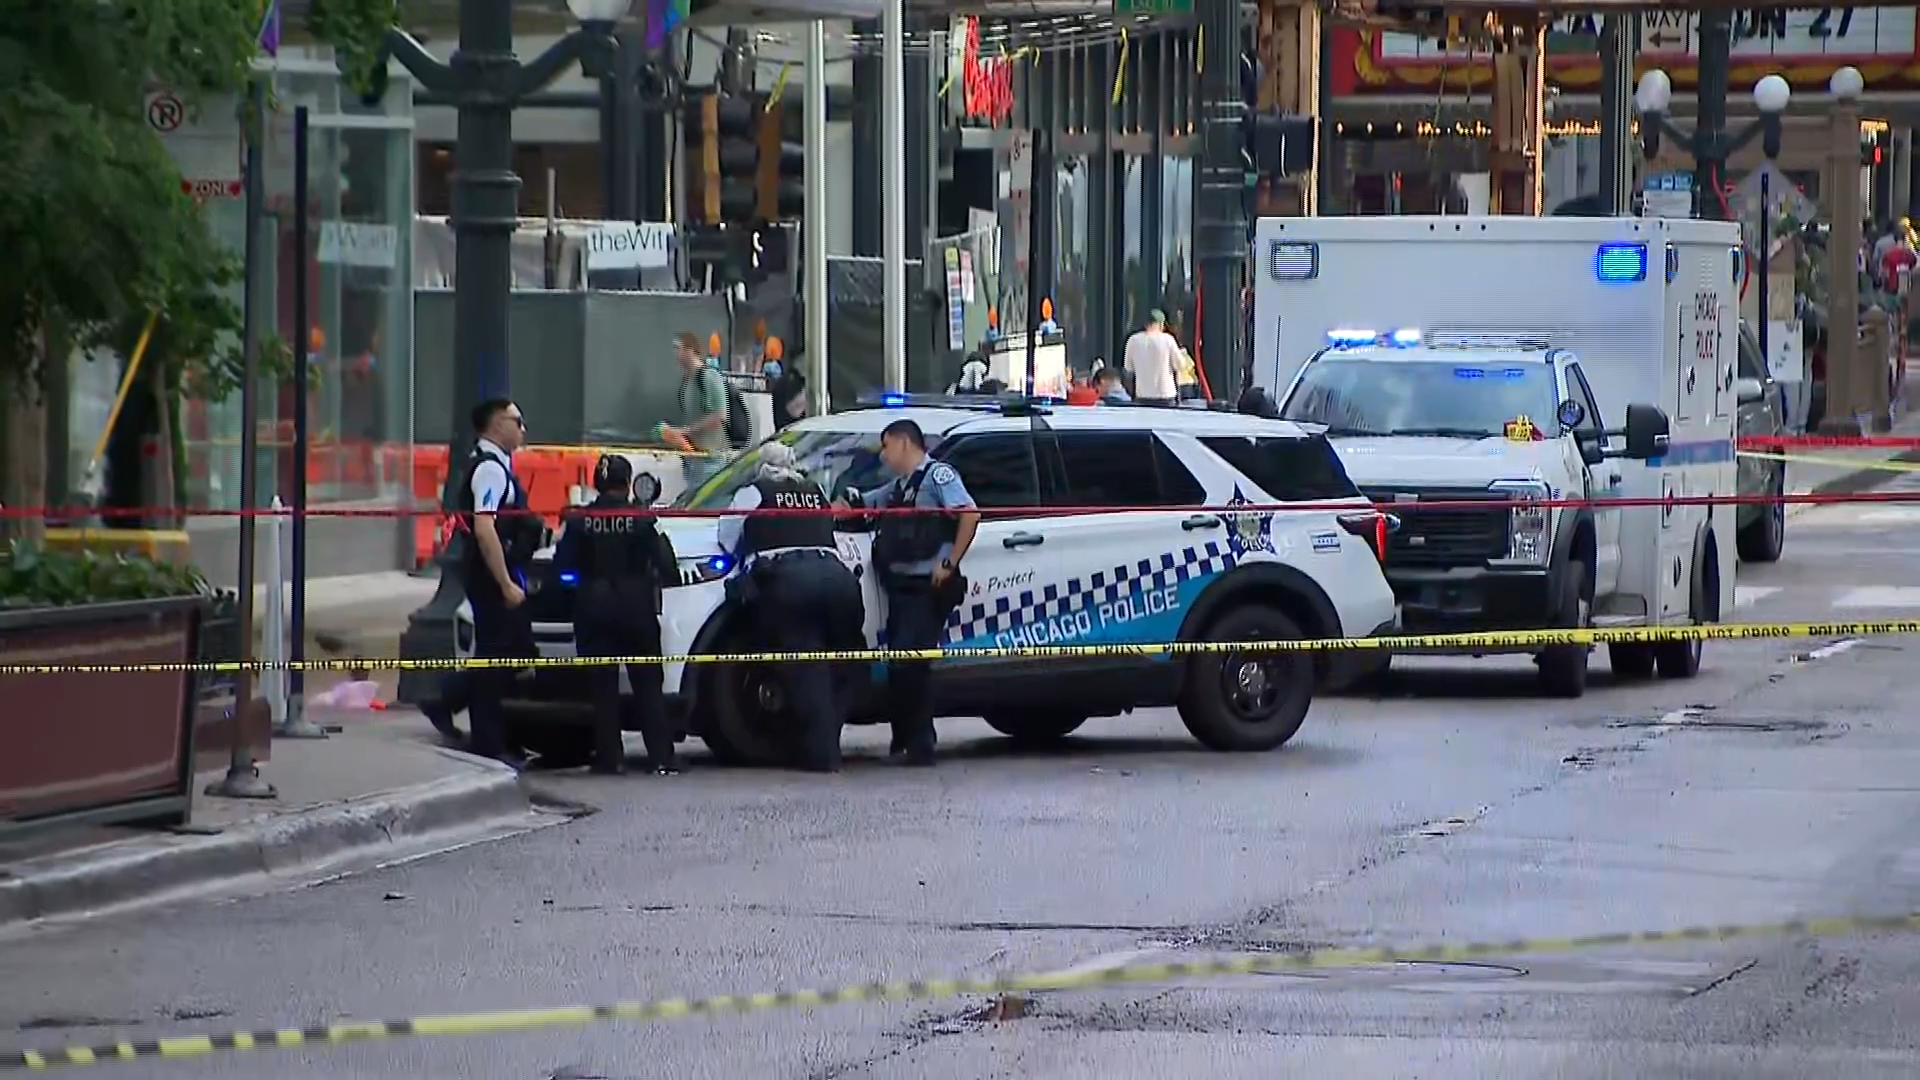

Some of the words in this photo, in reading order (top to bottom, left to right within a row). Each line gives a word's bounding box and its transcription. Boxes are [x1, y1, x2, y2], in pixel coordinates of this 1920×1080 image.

[1646, 10, 1683, 28] WAY
[775, 492, 821, 509] POLICE
[584, 516, 634, 533] POLICE
[994, 609, 1092, 650] CHICAGO
[1099, 586, 1181, 629] POLICE
